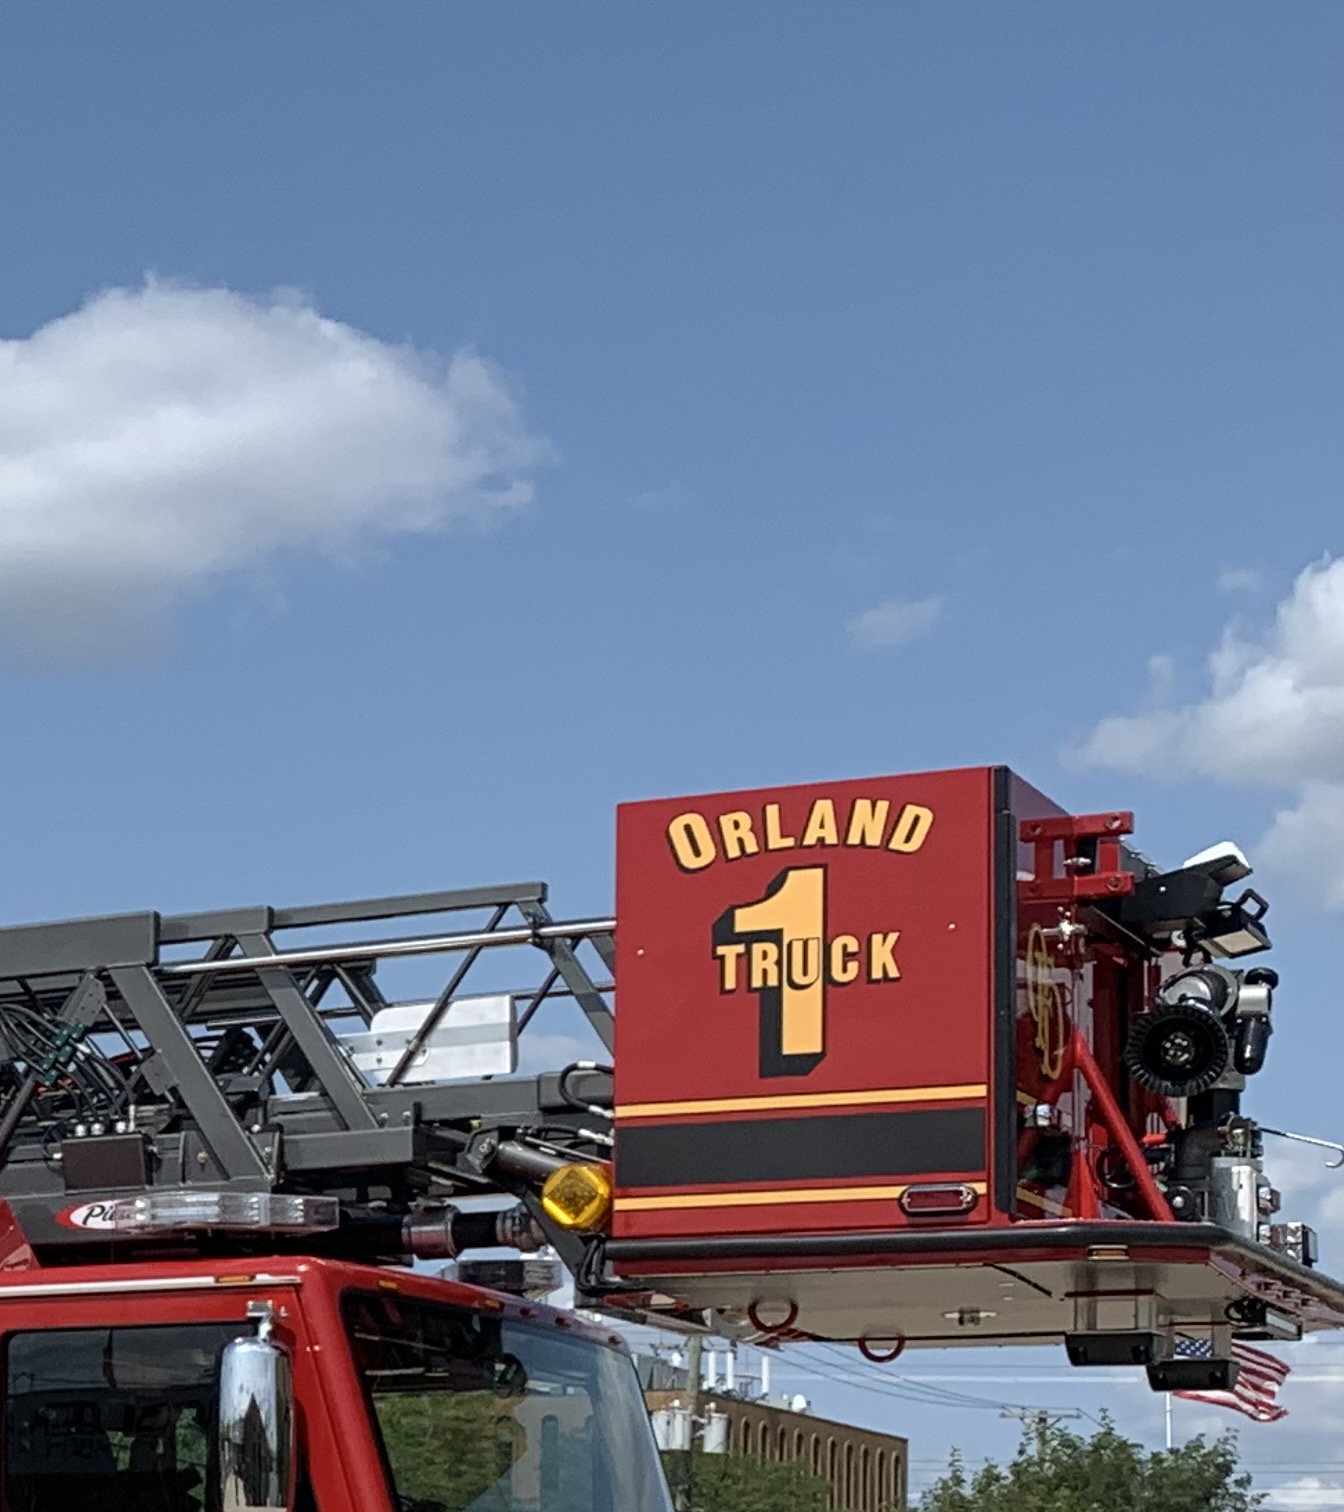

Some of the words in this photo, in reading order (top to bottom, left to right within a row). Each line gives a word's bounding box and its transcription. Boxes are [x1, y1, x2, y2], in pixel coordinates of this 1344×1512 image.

[666, 799, 934, 871] ORLAND
[713, 864, 826, 1077] 1
[716, 931, 901, 993] TRUCK
